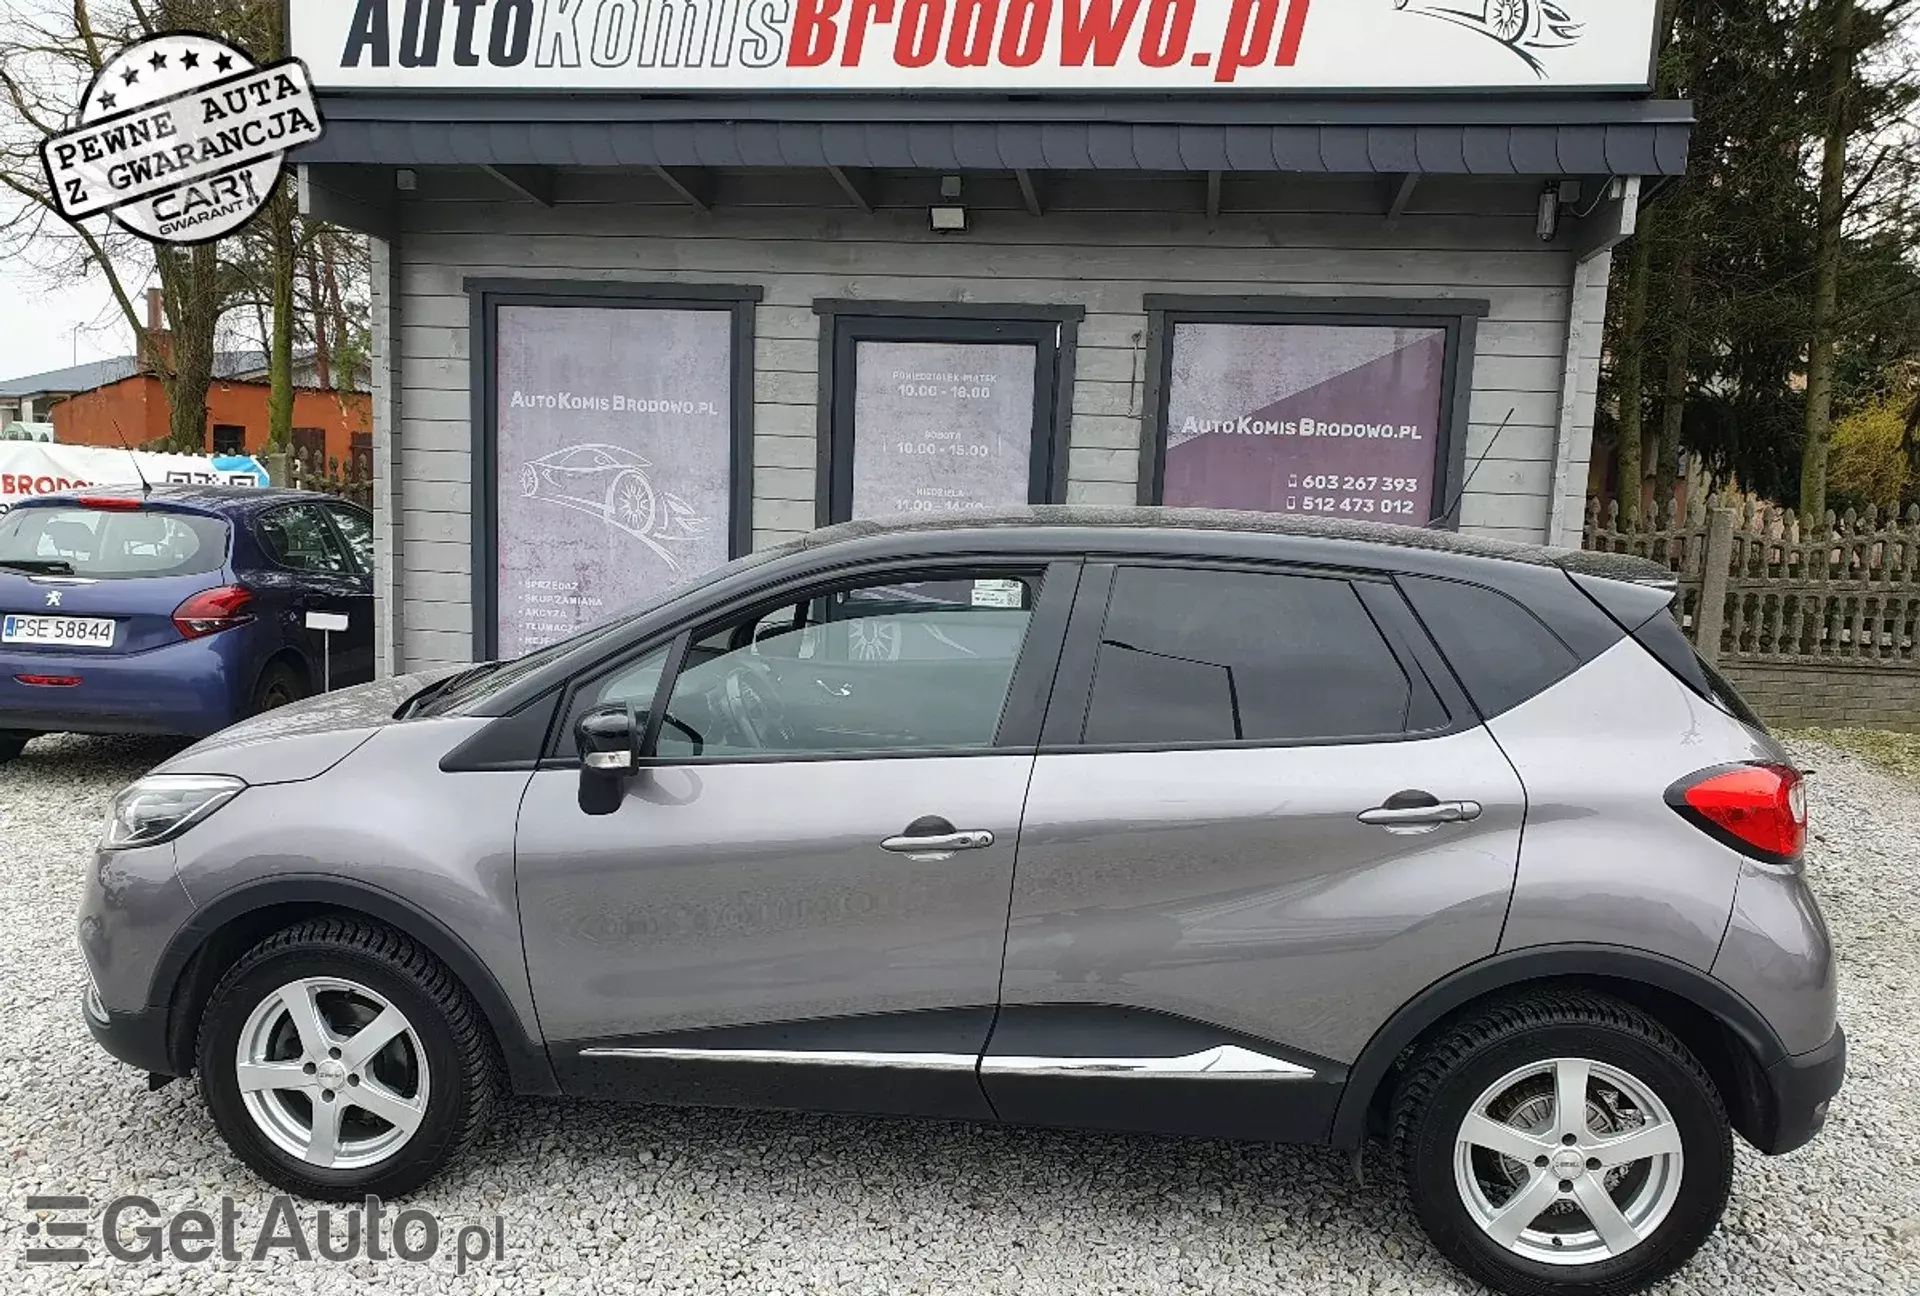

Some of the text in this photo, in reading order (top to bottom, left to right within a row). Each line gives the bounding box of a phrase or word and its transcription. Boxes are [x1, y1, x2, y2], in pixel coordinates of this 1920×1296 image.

[340, 0, 1309, 83] AutoKomisBrodowo.pl
[1302, 475, 1417, 492] 603 267 393
[1302, 498, 1414, 514] 512 473 012
[15, 619, 111, 641] PSE 58844
